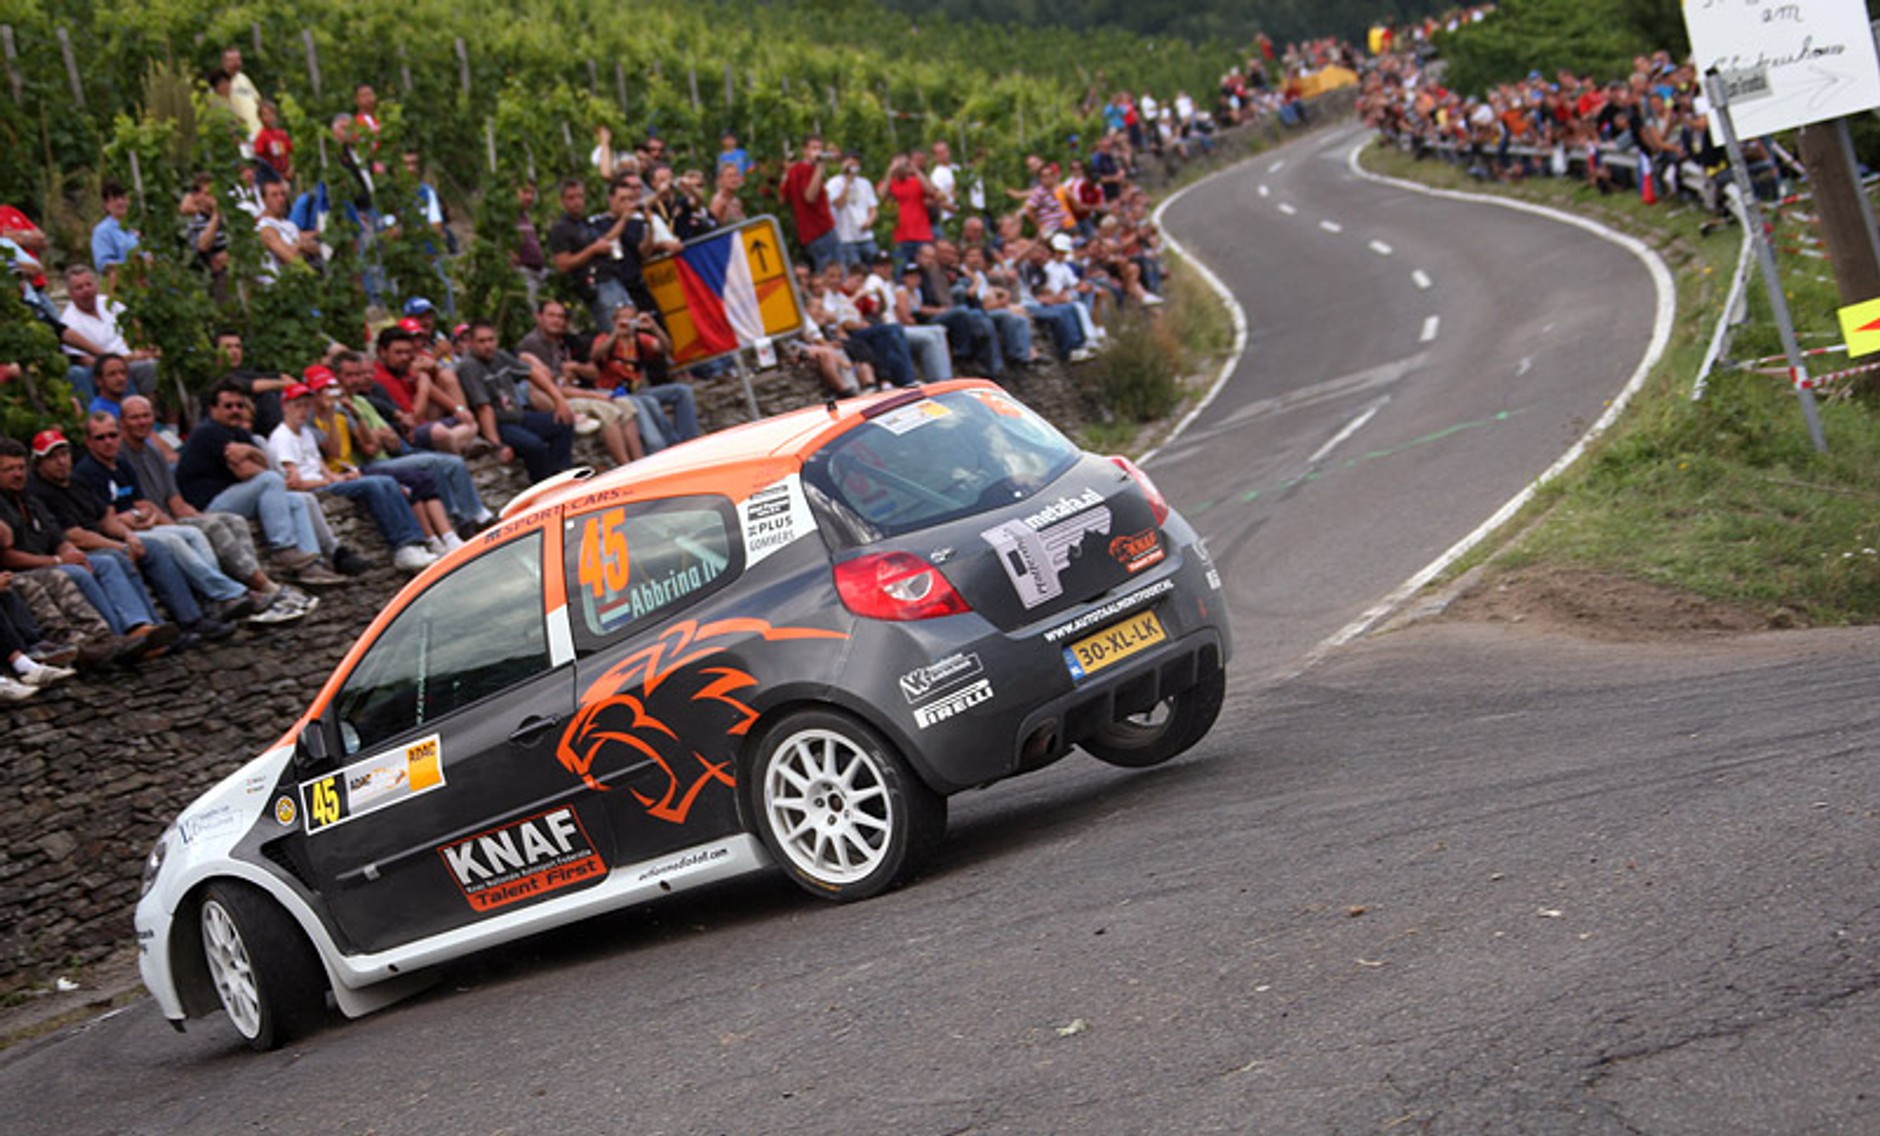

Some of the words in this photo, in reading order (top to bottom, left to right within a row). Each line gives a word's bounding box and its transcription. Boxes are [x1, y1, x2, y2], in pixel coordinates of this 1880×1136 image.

[758, 515, 793, 535] PLUS
[578, 507, 630, 598] 45
[1078, 617, 1159, 666] 30-XL-LK
[913, 678, 994, 729] PIRELLI
[312, 776, 340, 826] 45
[443, 808, 577, 885] KNAF
[475, 878, 539, 906] Talent
[547, 860, 598, 886] First
